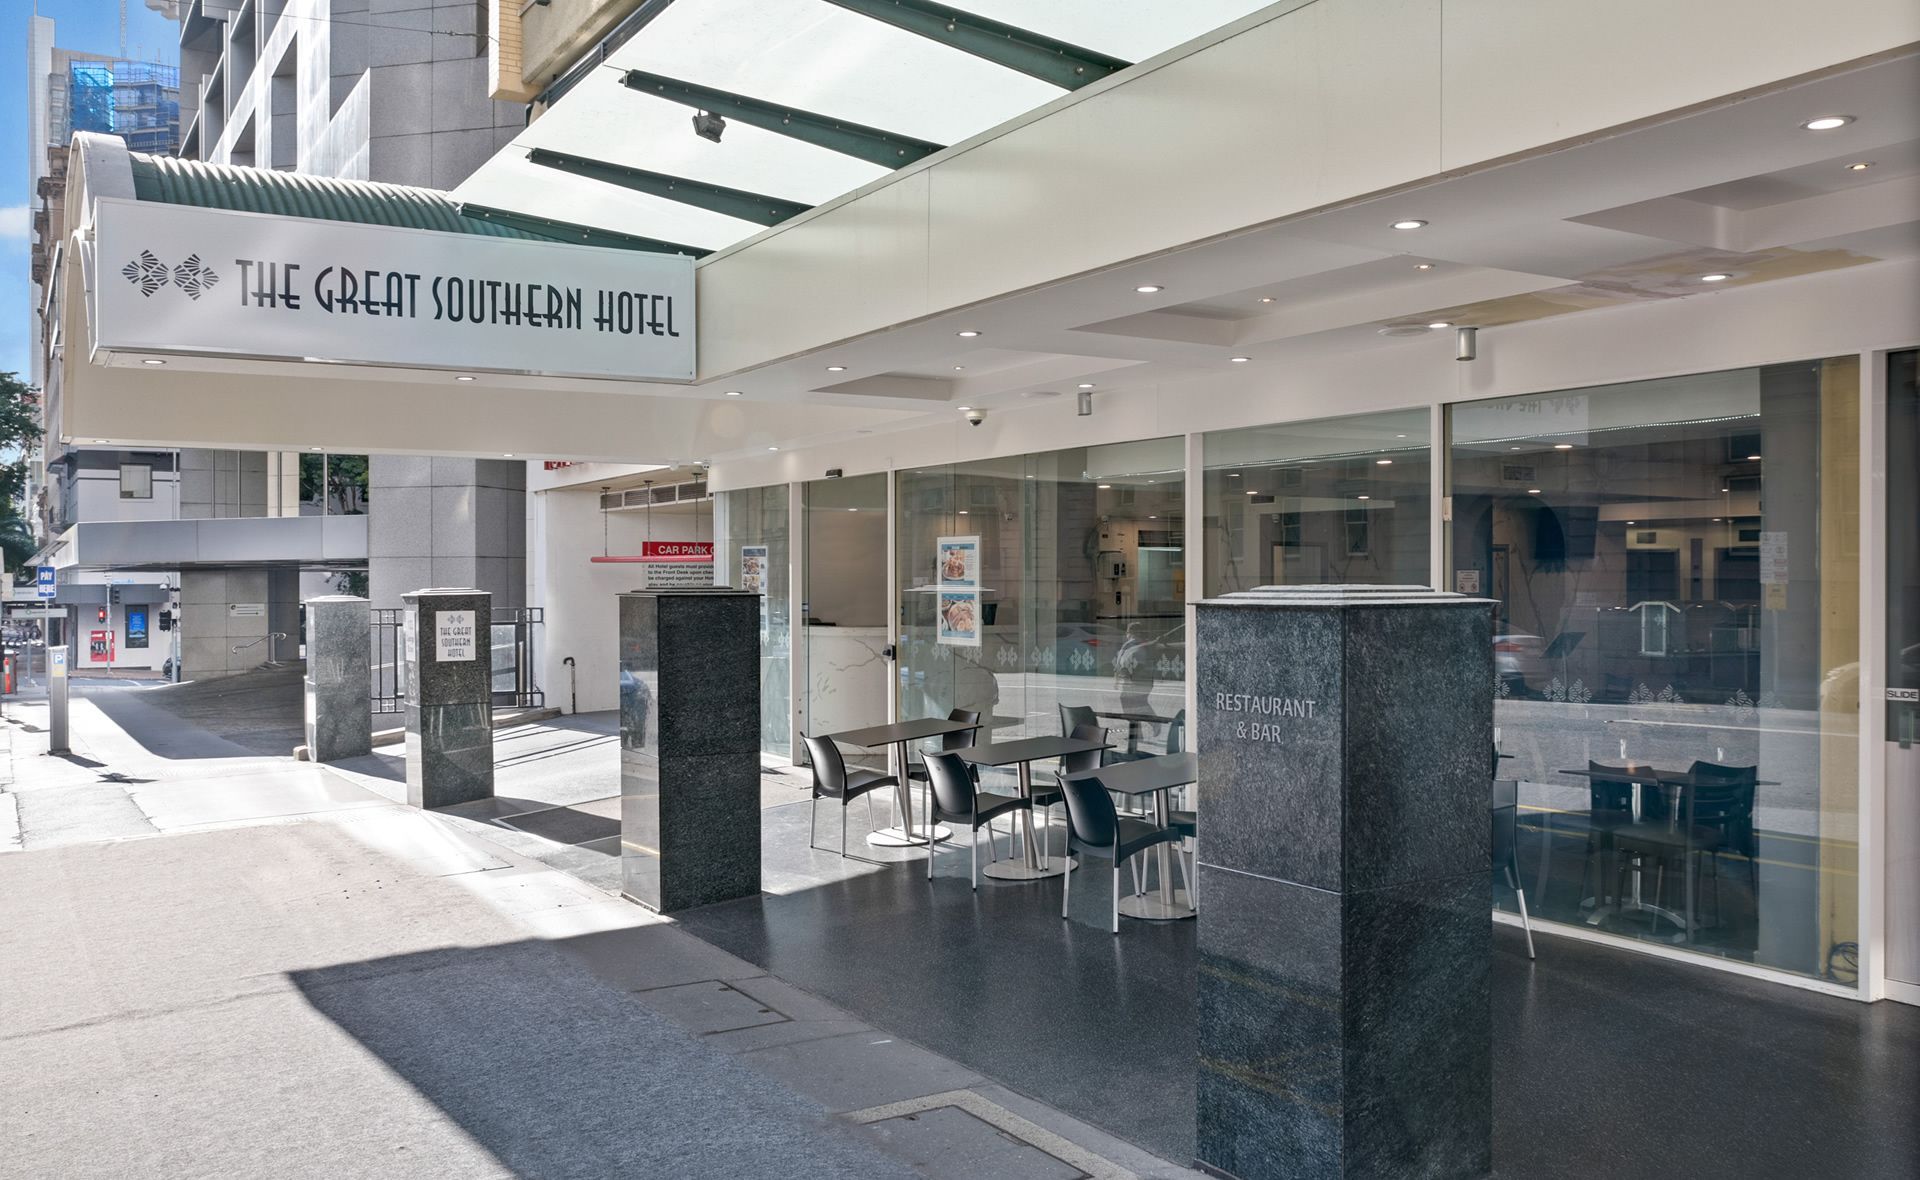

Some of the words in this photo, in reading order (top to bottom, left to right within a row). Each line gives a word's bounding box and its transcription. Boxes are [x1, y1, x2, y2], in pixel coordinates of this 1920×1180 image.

[235, 258, 301, 310] THE
[314, 265, 421, 320] GREAT
[432, 276, 582, 330] SOUTHERN
[593, 291, 680, 338] HOTEL
[658, 545, 679, 555] CAR
[682, 545, 708, 555] PARK
[40, 571, 53, 581] PAY
[440, 626, 451, 636] THE
[452, 626, 472, 636] GREAT
[441, 637, 471, 647] SOUTHERN
[447, 648, 465, 657] HOTEL
[1887, 690, 1918, 699] SLIDE
[1216, 692, 1316, 718] RESTAURANT
[1236, 721, 1247, 739] &
[1251, 722, 1281, 743] BAR
